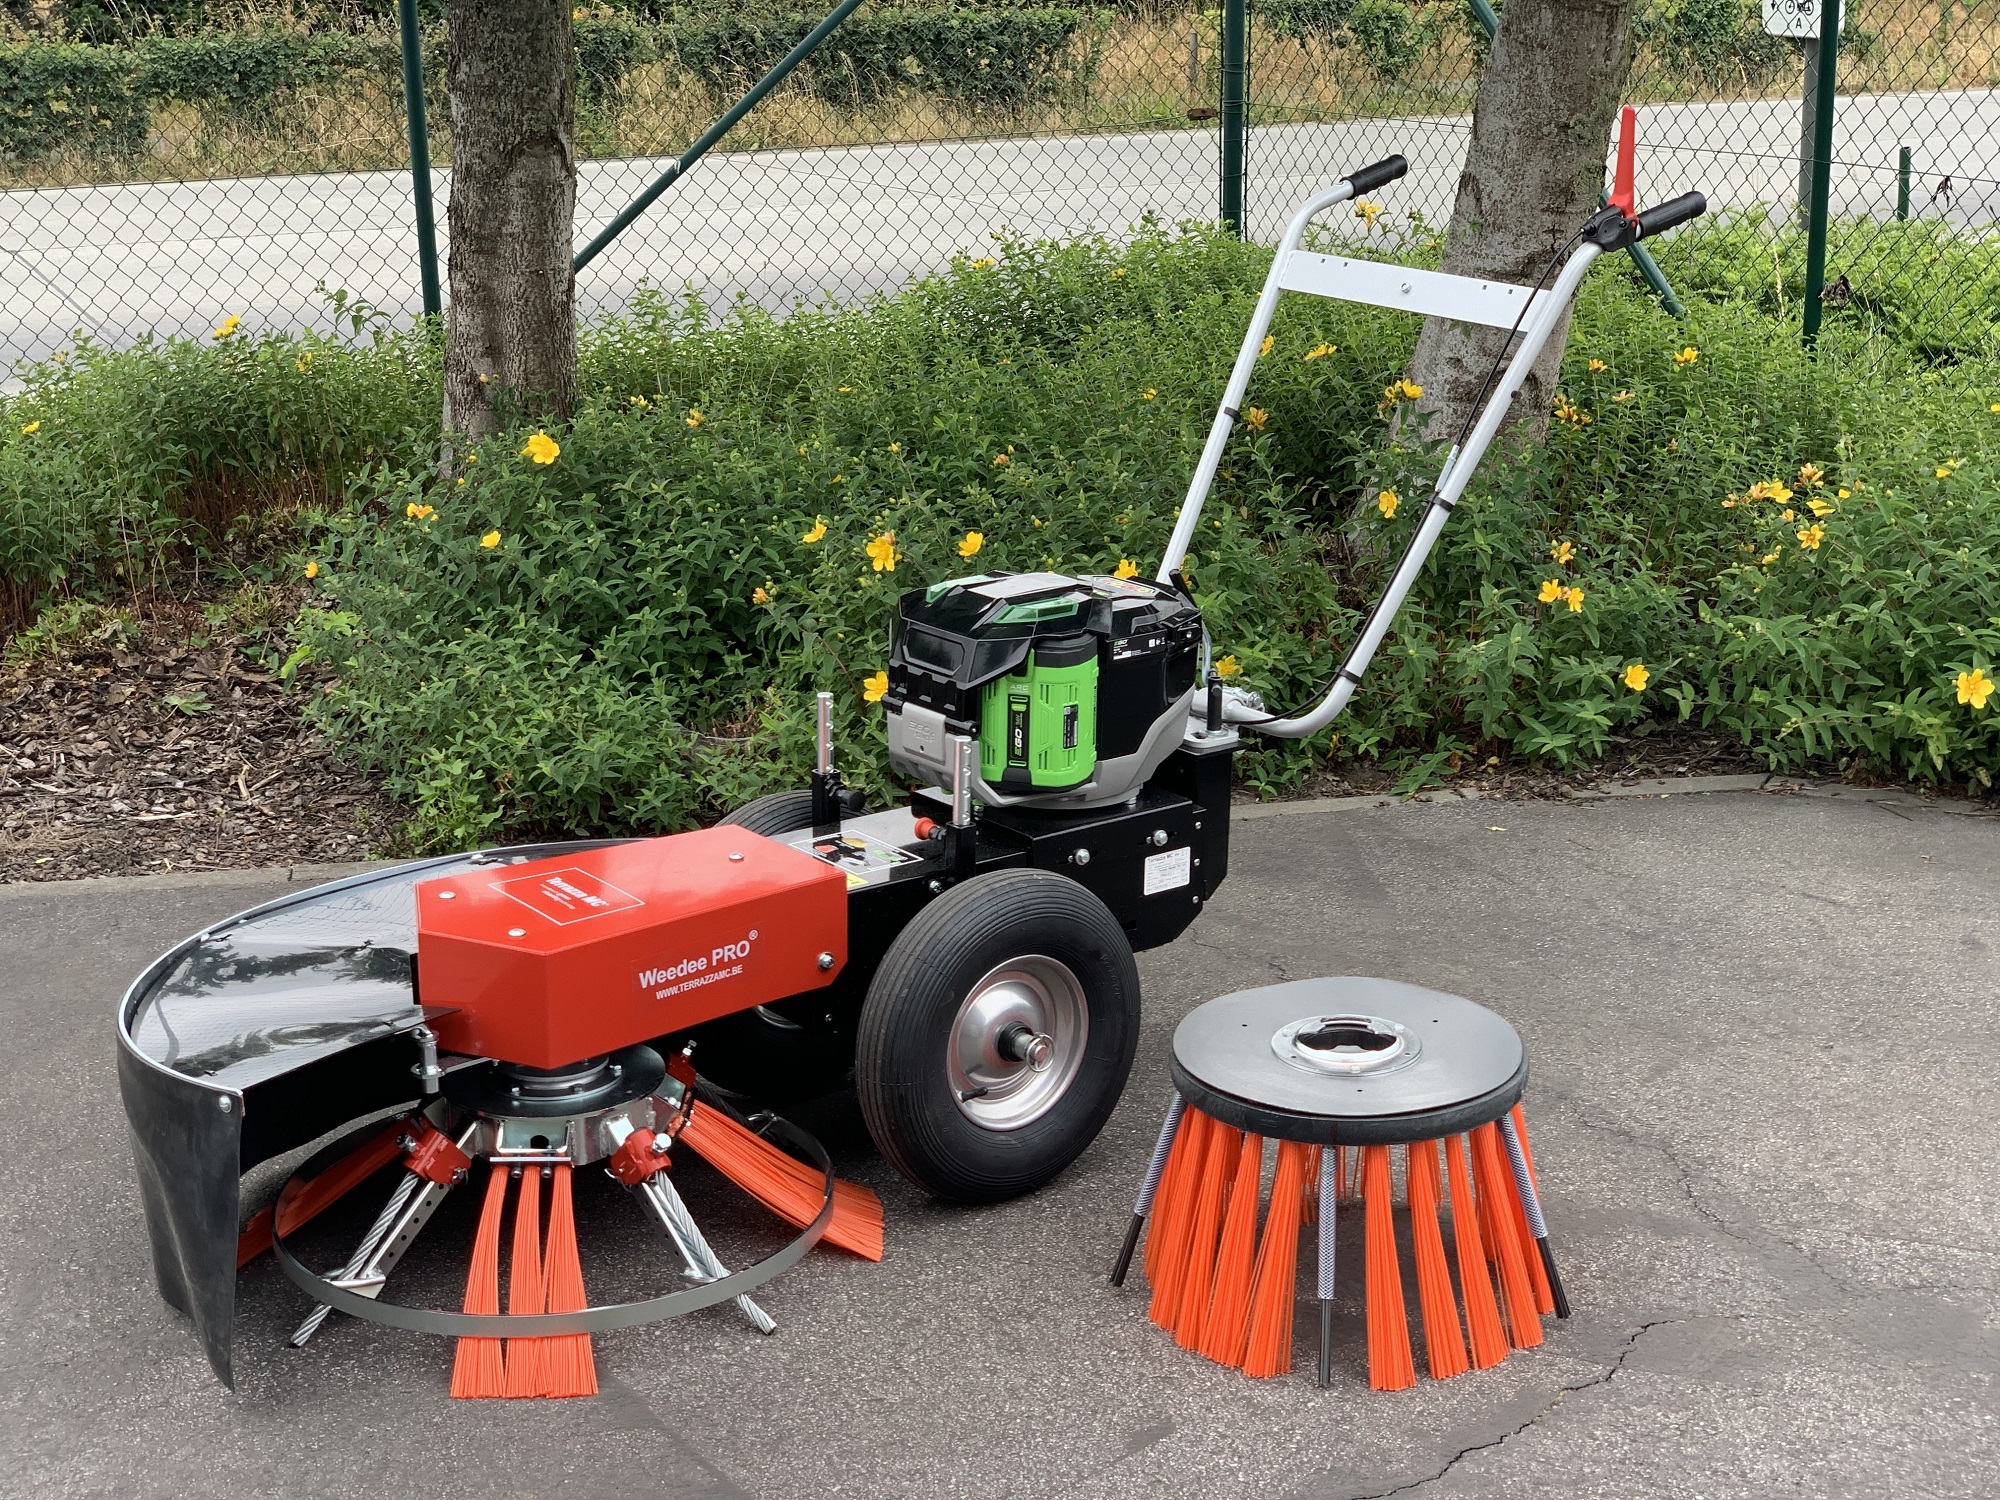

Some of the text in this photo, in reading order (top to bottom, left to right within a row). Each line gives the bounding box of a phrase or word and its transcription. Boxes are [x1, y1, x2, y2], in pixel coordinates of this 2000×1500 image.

[1795, 17, 1802, 29] A
[1014, 728, 1023, 756] EGO
[638, 957, 707, 989] Weedee
[656, 964, 744, 1000] WWW.TERRAZZAMC.BE
